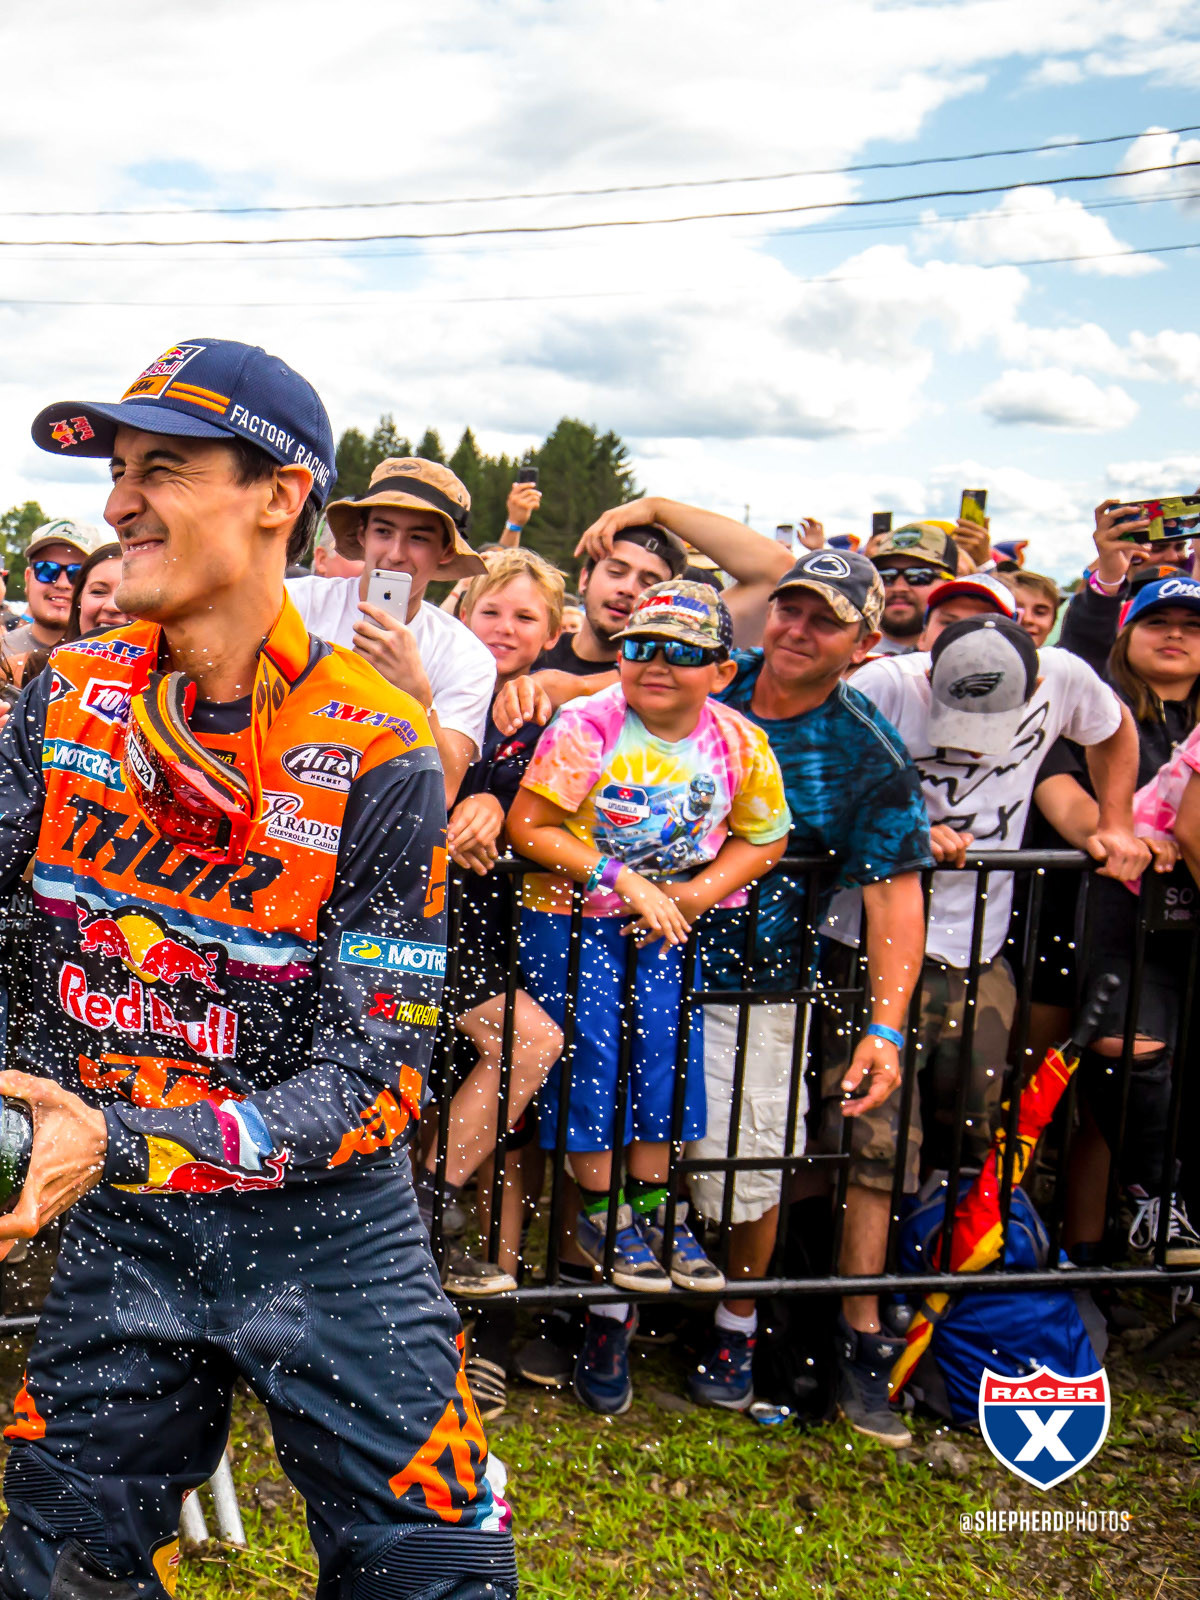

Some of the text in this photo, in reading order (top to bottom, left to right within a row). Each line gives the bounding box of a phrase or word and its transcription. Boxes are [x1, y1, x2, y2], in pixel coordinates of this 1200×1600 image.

[229, 404, 331, 487] FACTORY RACING
[310, 700, 419, 744] AMA PRO
[382, 722, 413, 748] RACING
[130, 742, 150, 783] 100%
[310, 774, 342, 786] HELMET
[61, 793, 285, 913] THOR
[268, 826, 310, 844] CHEVROLET
[58, 960, 239, 1059] Red Bull
